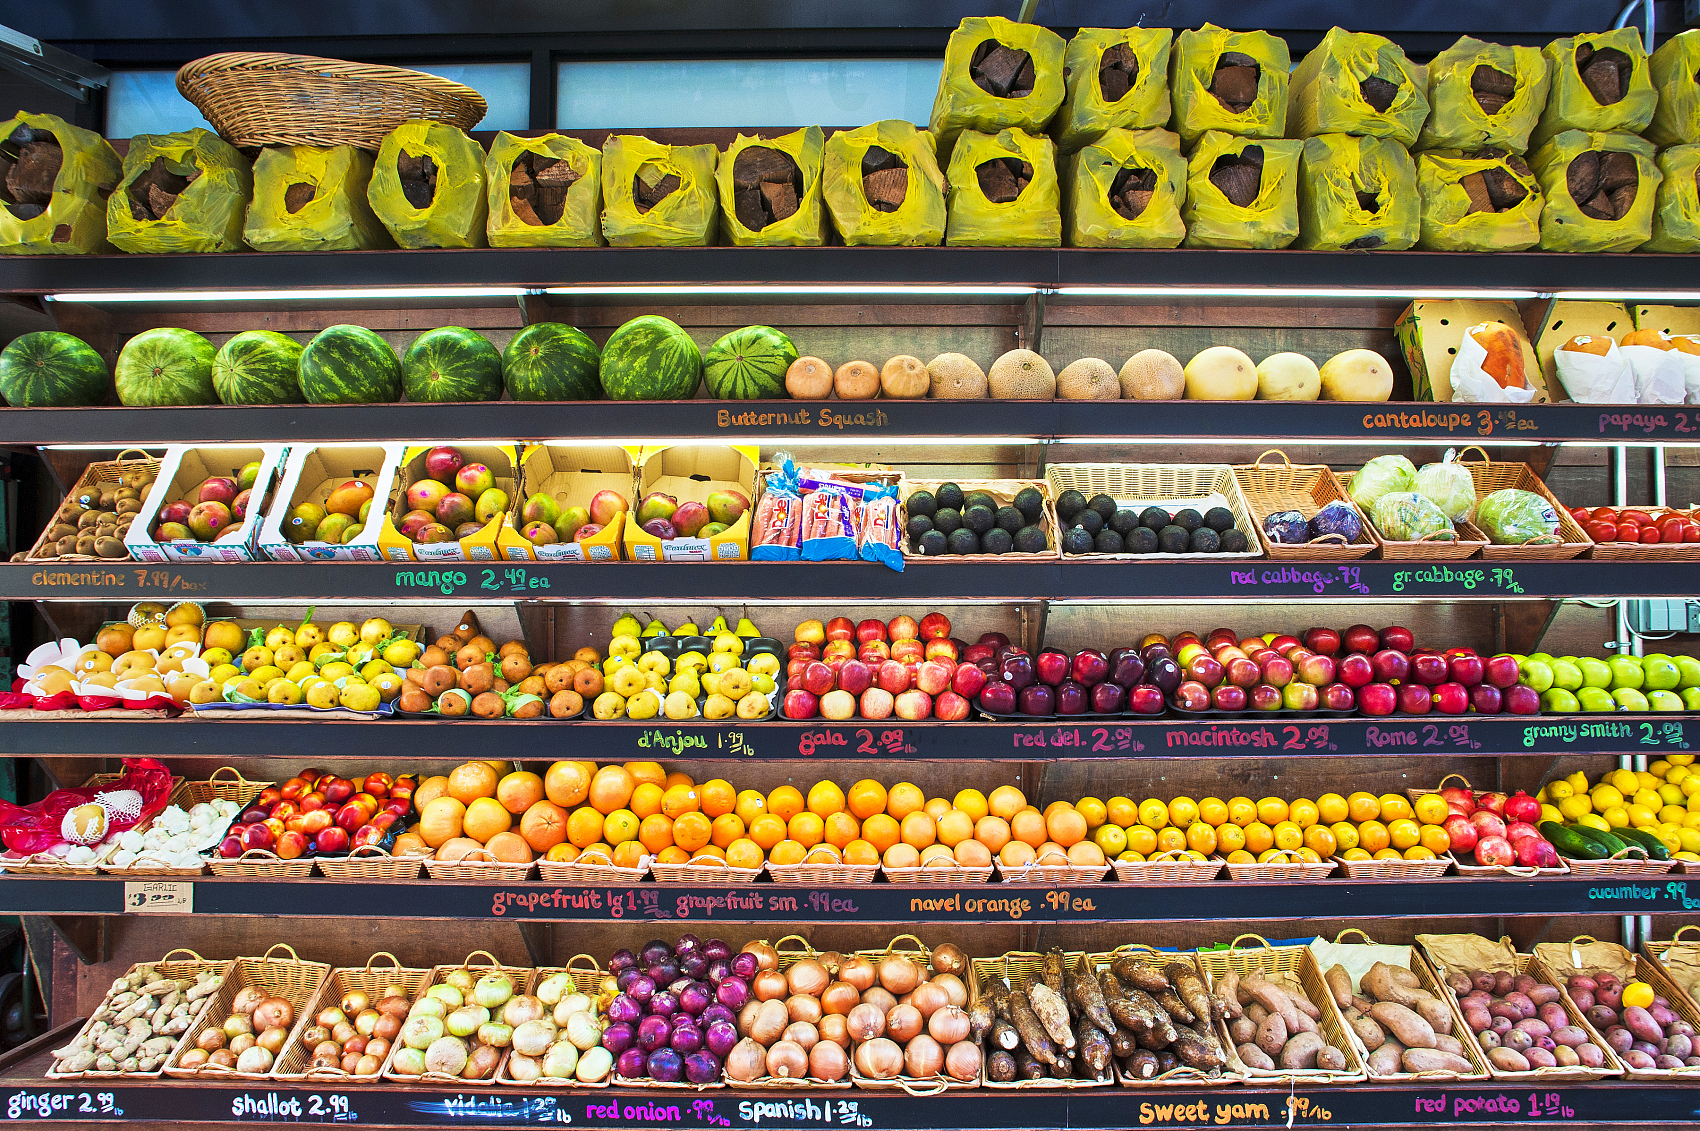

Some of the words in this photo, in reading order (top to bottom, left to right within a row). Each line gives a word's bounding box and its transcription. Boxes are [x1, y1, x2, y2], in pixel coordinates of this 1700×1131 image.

[717, 408, 811, 428] Butternut
[818, 408, 890, 429] Squash
[1362, 410, 1472, 431] cantaloupe
[1599, 413, 1669, 433] papaya
[31, 569, 125, 586] clementine
[395, 570, 467, 595] mango
[1230, 568, 1258, 585] red
[1261, 566, 1334, 594] cabbage
[1414, 565, 1485, 590] cabbage
[637, 729, 708, 756] d'Anjou
[798, 729, 848, 756] gala
[1013, 729, 1047, 747] red
[1050, 727, 1088, 747] del.
[1166, 725, 1279, 748] macintosh
[1366, 725, 1418, 748] Rome
[1522, 724, 1578, 748] granny
[1579, 721, 1634, 738] smith
[491, 888, 602, 916] grapefruit
[606, 890, 624, 918] lg
[676, 890, 764, 918] grapefruit
[768, 896, 799, 911] sm
[1588, 883, 1661, 900] cucumber
[910, 892, 960, 912] navel
[964, 898, 1032, 919] orange
[7, 1090, 76, 1119] ginger
[231, 1092, 303, 1117] shallot
[586, 1098, 620, 1119] red
[623, 1100, 682, 1121] onion
[738, 1097, 822, 1123] Spanish
[1214, 1103, 1270, 1125] yam
[1415, 1093, 1447, 1113] red
[1454, 1093, 1521, 1118] potato
